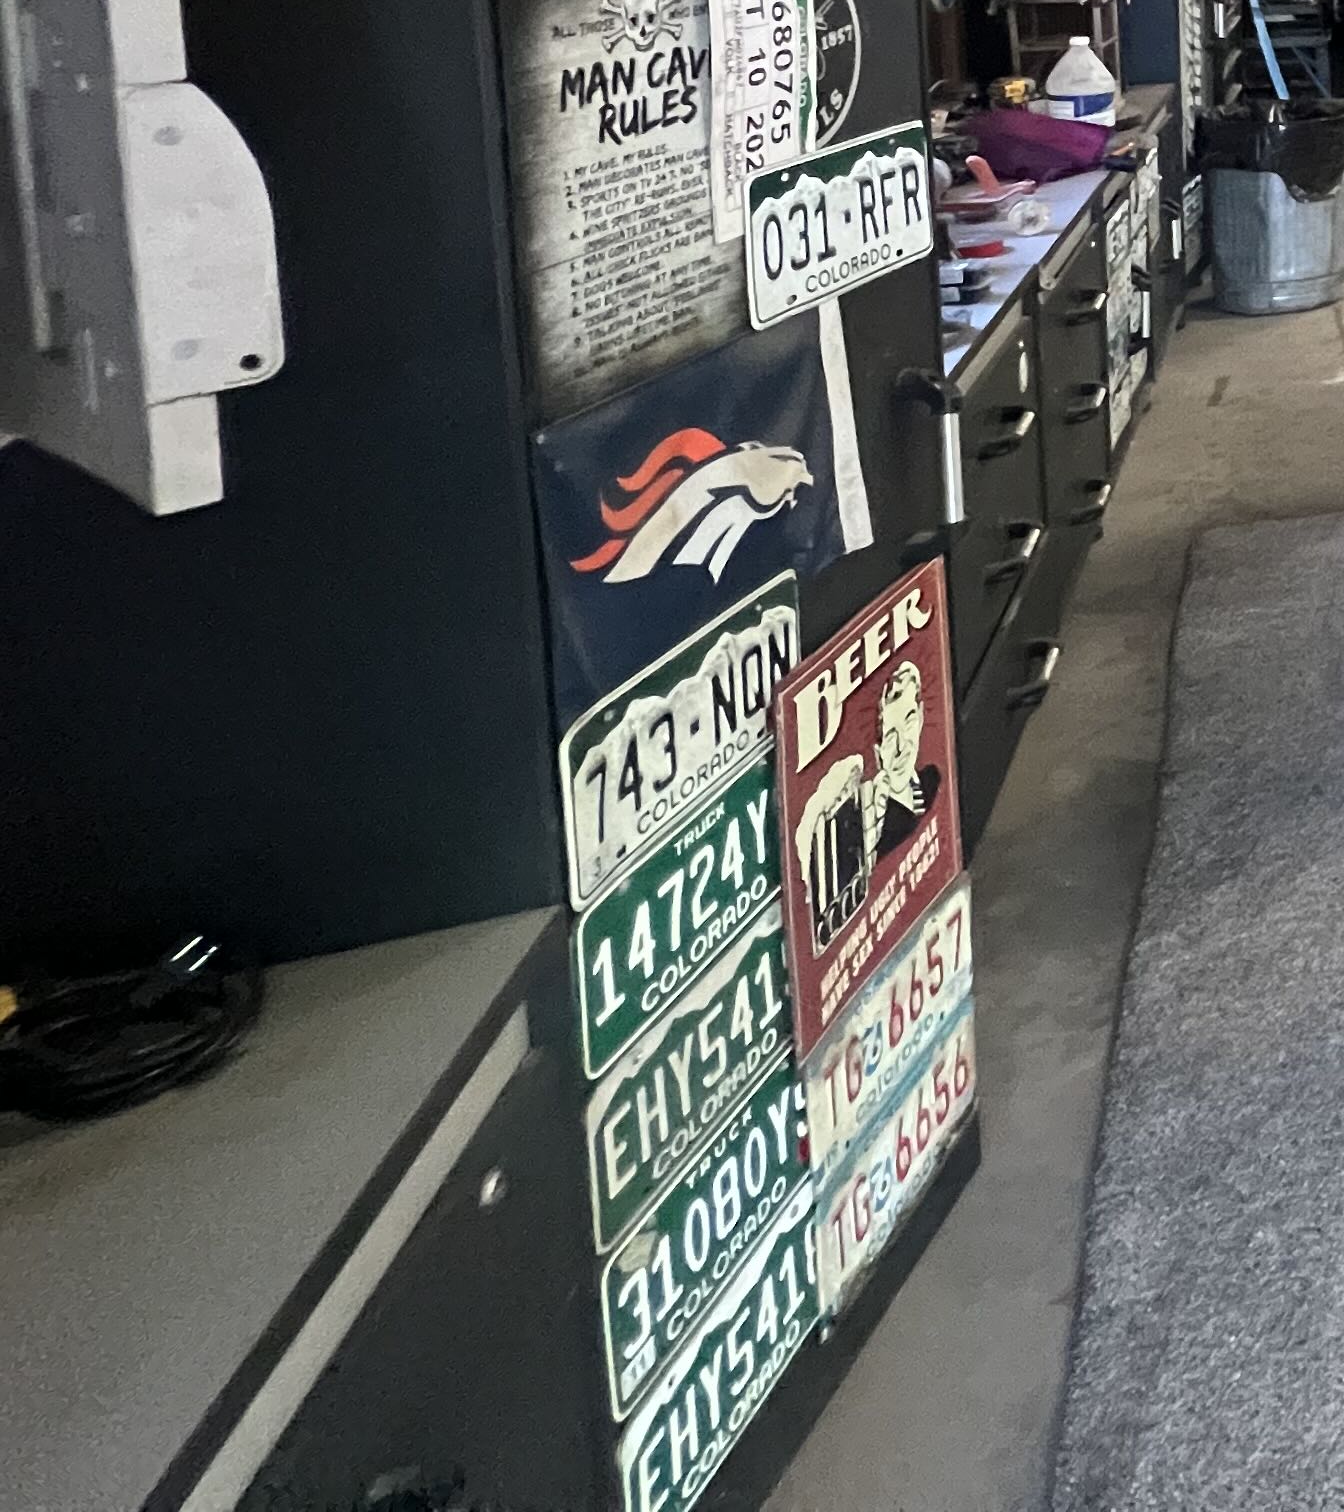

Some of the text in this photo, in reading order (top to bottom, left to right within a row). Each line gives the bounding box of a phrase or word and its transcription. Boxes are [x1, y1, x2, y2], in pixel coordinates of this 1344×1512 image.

[560, 45, 713, 113] MAN CAV
[747, 46, 768, 87] 10
[821, 24, 853, 52] 1857
[599, 85, 698, 146] RULES
[744, 112, 765, 171] 202
[804, 242, 892, 294] COLORADO
[793, 587, 935, 775] BEER
[636, 730, 750, 835] COLORADO
[673, 801, 726, 856] TRUCK
[592, 789, 769, 1026] 14724Y
[641, 874, 768, 1012] COLORADO
[852, 932, 874, 977] SEX
[603, 951, 784, 1201] EHY541
[652, 1027, 777, 1180] COLORADO
[685, 1104, 752, 1189] TRUCK
[666, 1176, 787, 1342] COLORADO
[681, 1318, 801, 1499] COLORADO
